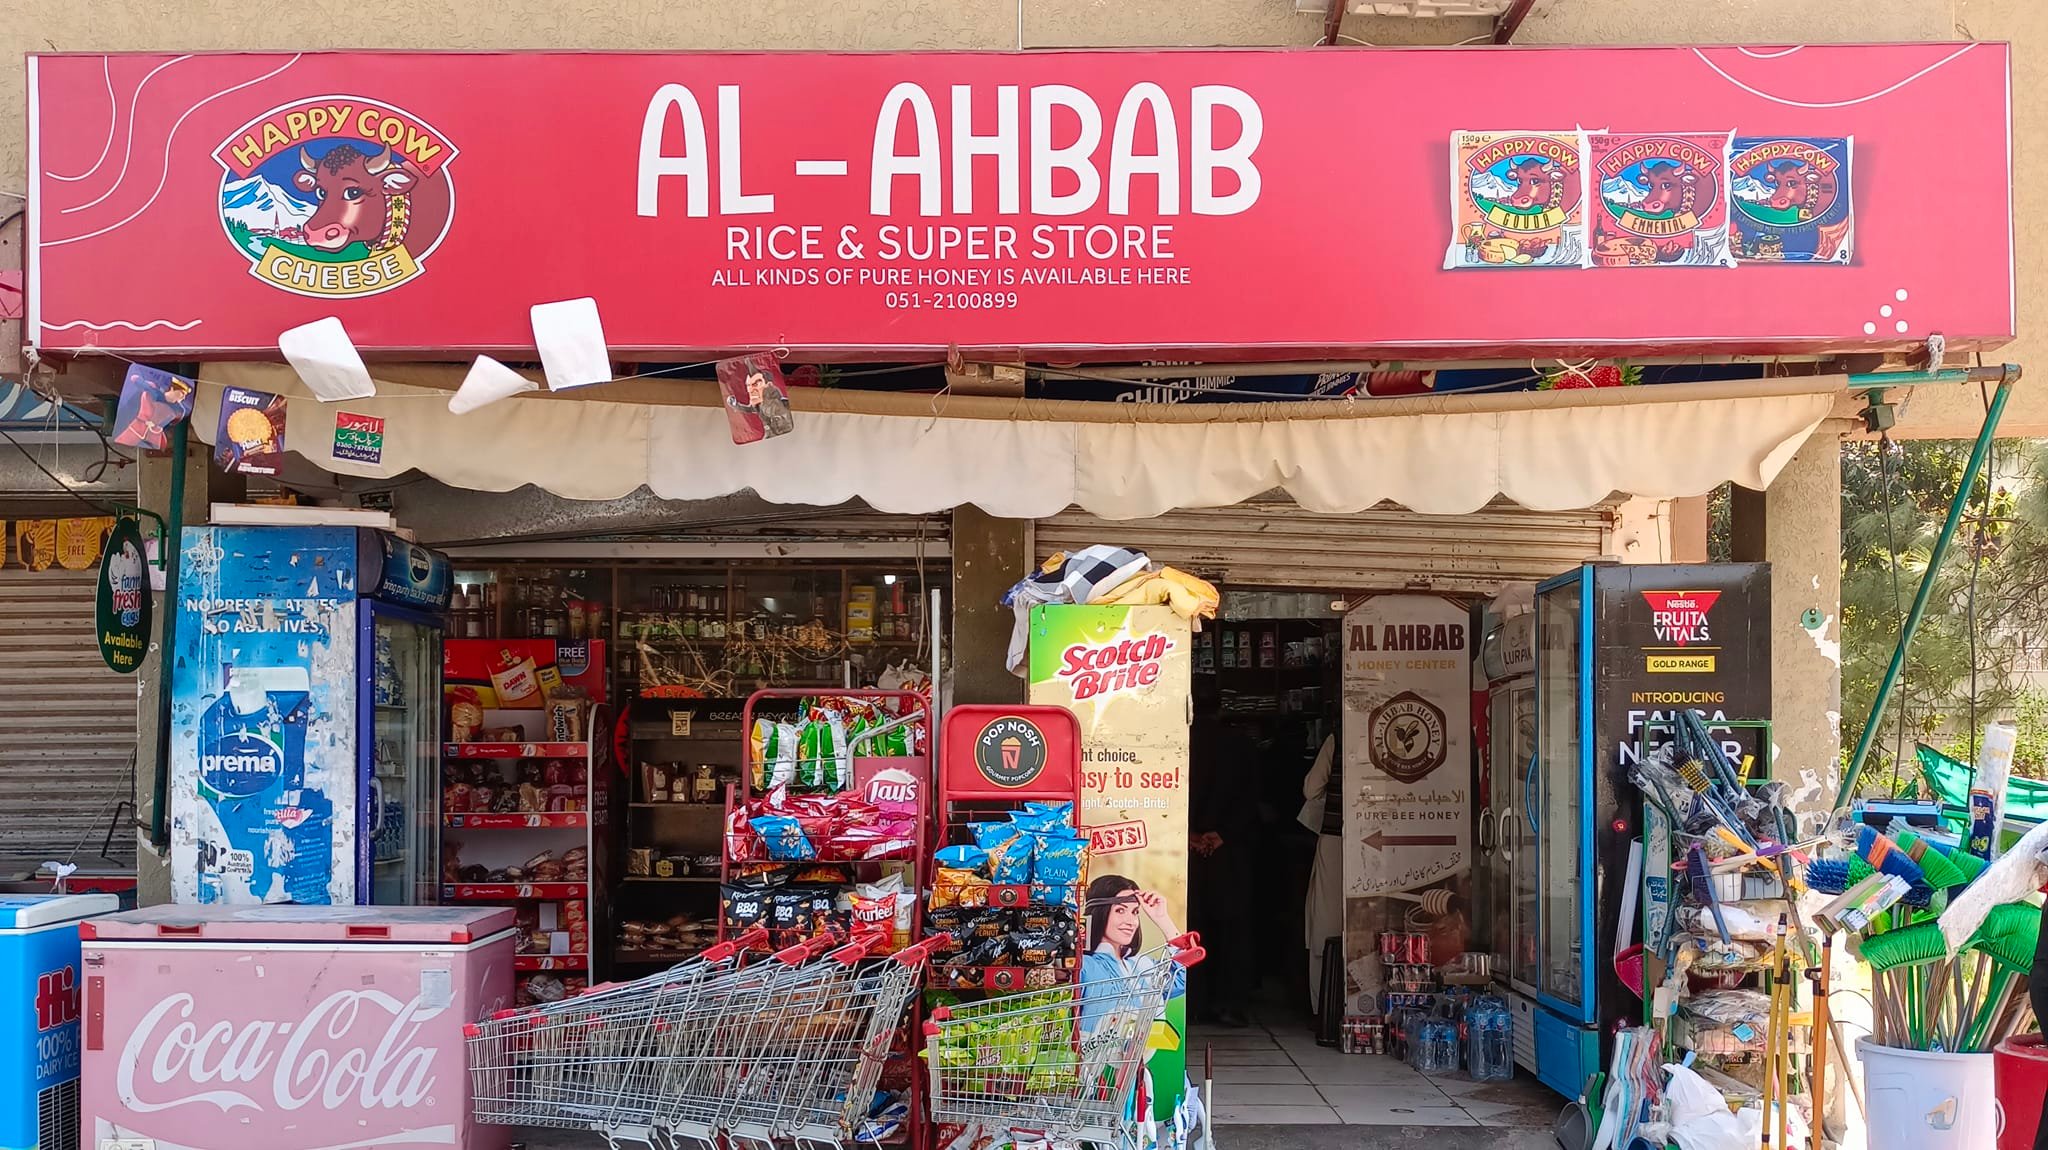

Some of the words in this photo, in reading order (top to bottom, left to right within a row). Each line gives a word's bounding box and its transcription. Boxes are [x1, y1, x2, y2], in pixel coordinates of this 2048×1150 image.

[231, 105, 351, 168] HAPPY
[356, 108, 441, 164] COW
[636, 82, 774, 217] AL
[870, 82, 1264, 217] AHBAB
[1477, 140, 1536, 168] HAPPY
[1538, 141, 1578, 167] COW
[1606, 142, 1667, 172] HAPPY
[1669, 144, 1711, 170] COW
[1737, 144, 1791, 171] HAPPY
[1794, 145, 1832, 169] COW
[1502, 213, 1551, 229] GOUDA
[1631, 217, 1686, 234] EMMENTAL
[726, 226, 823, 261] RICE
[837, 226, 865, 261] &
[878, 225, 1018, 261] SUPER
[1031, 224, 1175, 260] STORE
[1840, 249, 1847, 259] 8
[270, 254, 403, 290] CHEESE
[712, 268, 751, 287] ALL
[756, 268, 819, 287] KINDS
[825, 268, 855, 287] OF
[860, 268, 913, 287] PURE
[918, 268, 991, 286] HONEY
[996, 268, 1015, 286] IS
[1020, 267, 1132, 286] AVAILABLE
[1138, 267, 1191, 285] HERE
[885, 292, 1018, 310] 051-2100899
[229, 393, 260, 406] BISCUIT
[343, 420, 379, 433] لاہور
[121, 574, 140, 592] farm
[112, 589, 142, 615] fresh
[186, 599, 210, 612] NO
[1653, 611, 1709, 626] FRUITA
[104, 632, 143, 649] Available
[1350, 624, 1377, 651] AL
[1382, 624, 1465, 651] AHBAB
[113, 652, 133, 665] Here
[558, 647, 585, 657] FREE
[1058, 634, 1174, 676] Scotch-
[1357, 660, 1400, 670] HONEY
[1406, 659, 1456, 670] CENTER
[1653, 660, 1677, 668] GOLD
[1679, 660, 1709, 668] RANGE
[504, 671, 527, 690] DAWN
[1071, 660, 1163, 700] Brite
[1631, 691, 1725, 704] INTRODUCING
[983, 723, 1005, 746] POP
[1007, 721, 1041, 747] NOSH
[1416, 706, 1441, 746] HONEY
[1097, 748, 1136, 762] choice
[985, 765, 1010, 782] GOURMET
[1011, 766, 1035, 782] POPCORN
[1115, 767, 1133, 789] to
[1140, 766, 1180, 789] see!
[870, 780, 916, 803] Lay's
[1356, 811, 1388, 820] PURE
[1392, 811, 1415, 820] BEE
[1419, 811, 1460, 820] HONEY
[230, 853, 249, 862] 100%
[1044, 867, 1068, 878] PLAIN
[735, 902, 758, 914] BBQ
[775, 905, 793, 918] BBQ
[36, 1028, 72, 1062] 100%
[117, 988, 458, 1114] Coca-Cola
[36, 1057, 63, 1080] DAIRY
[64, 1051, 79, 1069] ICE
